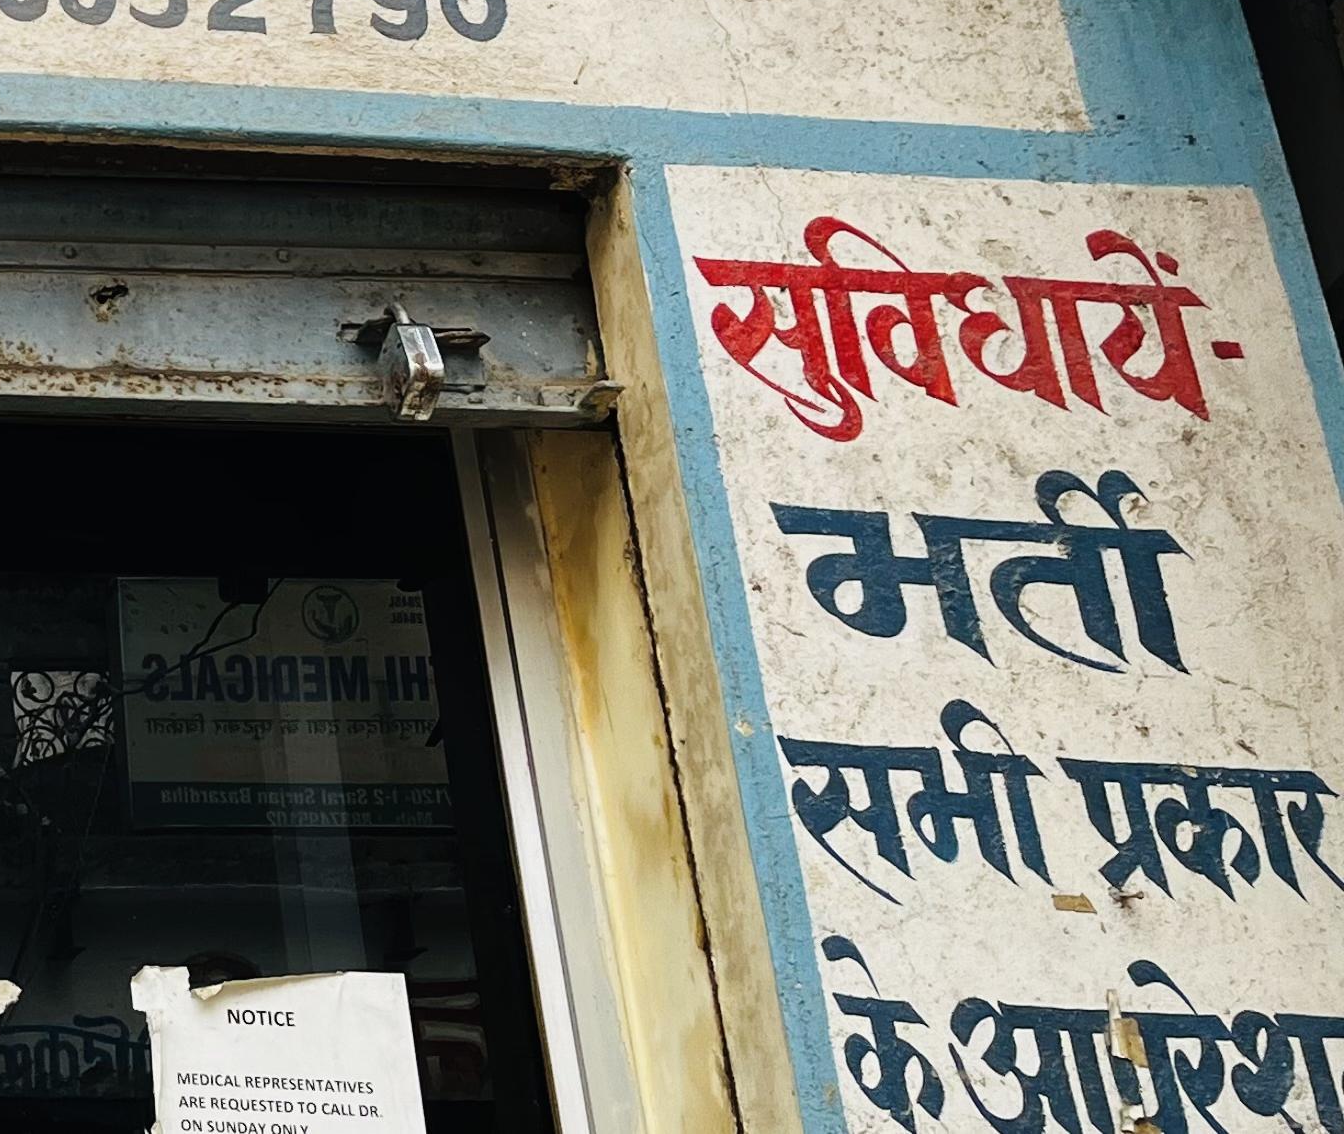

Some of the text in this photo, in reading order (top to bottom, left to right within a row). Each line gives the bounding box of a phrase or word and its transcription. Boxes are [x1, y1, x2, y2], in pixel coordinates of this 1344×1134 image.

[777, 699, 1054, 906] सभी
[227, 1008, 296, 1027] NOTICE
[177, 1072, 374, 1095] MEDICAL REPRESENTATIVES
[179, 1096, 384, 1118] ARE REQUESTED TO CALL DR.
[181, 1118, 202, 1133] ON
[207, 1120, 265, 1134] SUNDAY
